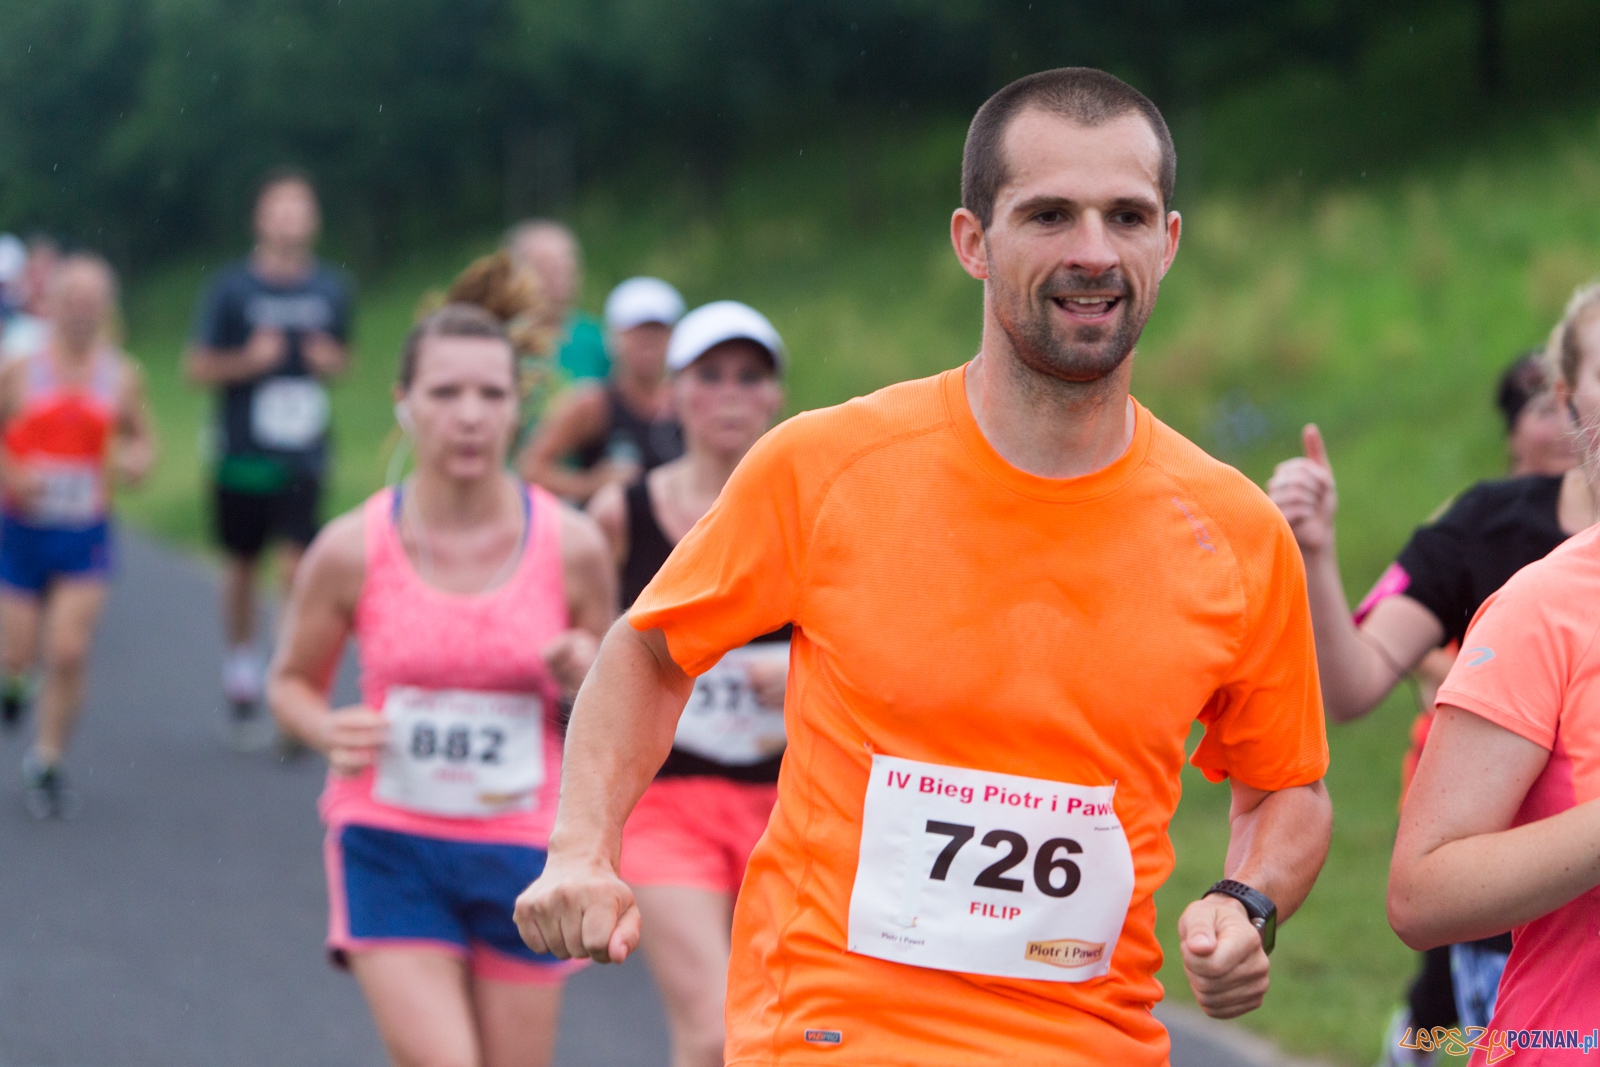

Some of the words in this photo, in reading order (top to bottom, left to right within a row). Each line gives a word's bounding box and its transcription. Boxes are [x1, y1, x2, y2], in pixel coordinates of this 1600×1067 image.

[411, 721, 506, 765] 882
[887, 770, 912, 788] IV
[919, 776, 975, 804] Bieg
[983, 785, 1043, 810] Piotr
[1051, 795, 1058, 812] i
[925, 820, 1083, 898] 726
[969, 902, 1022, 921] FILIP
[1029, 943, 1061, 957] Piotr
[1064, 946, 1069, 958] i
